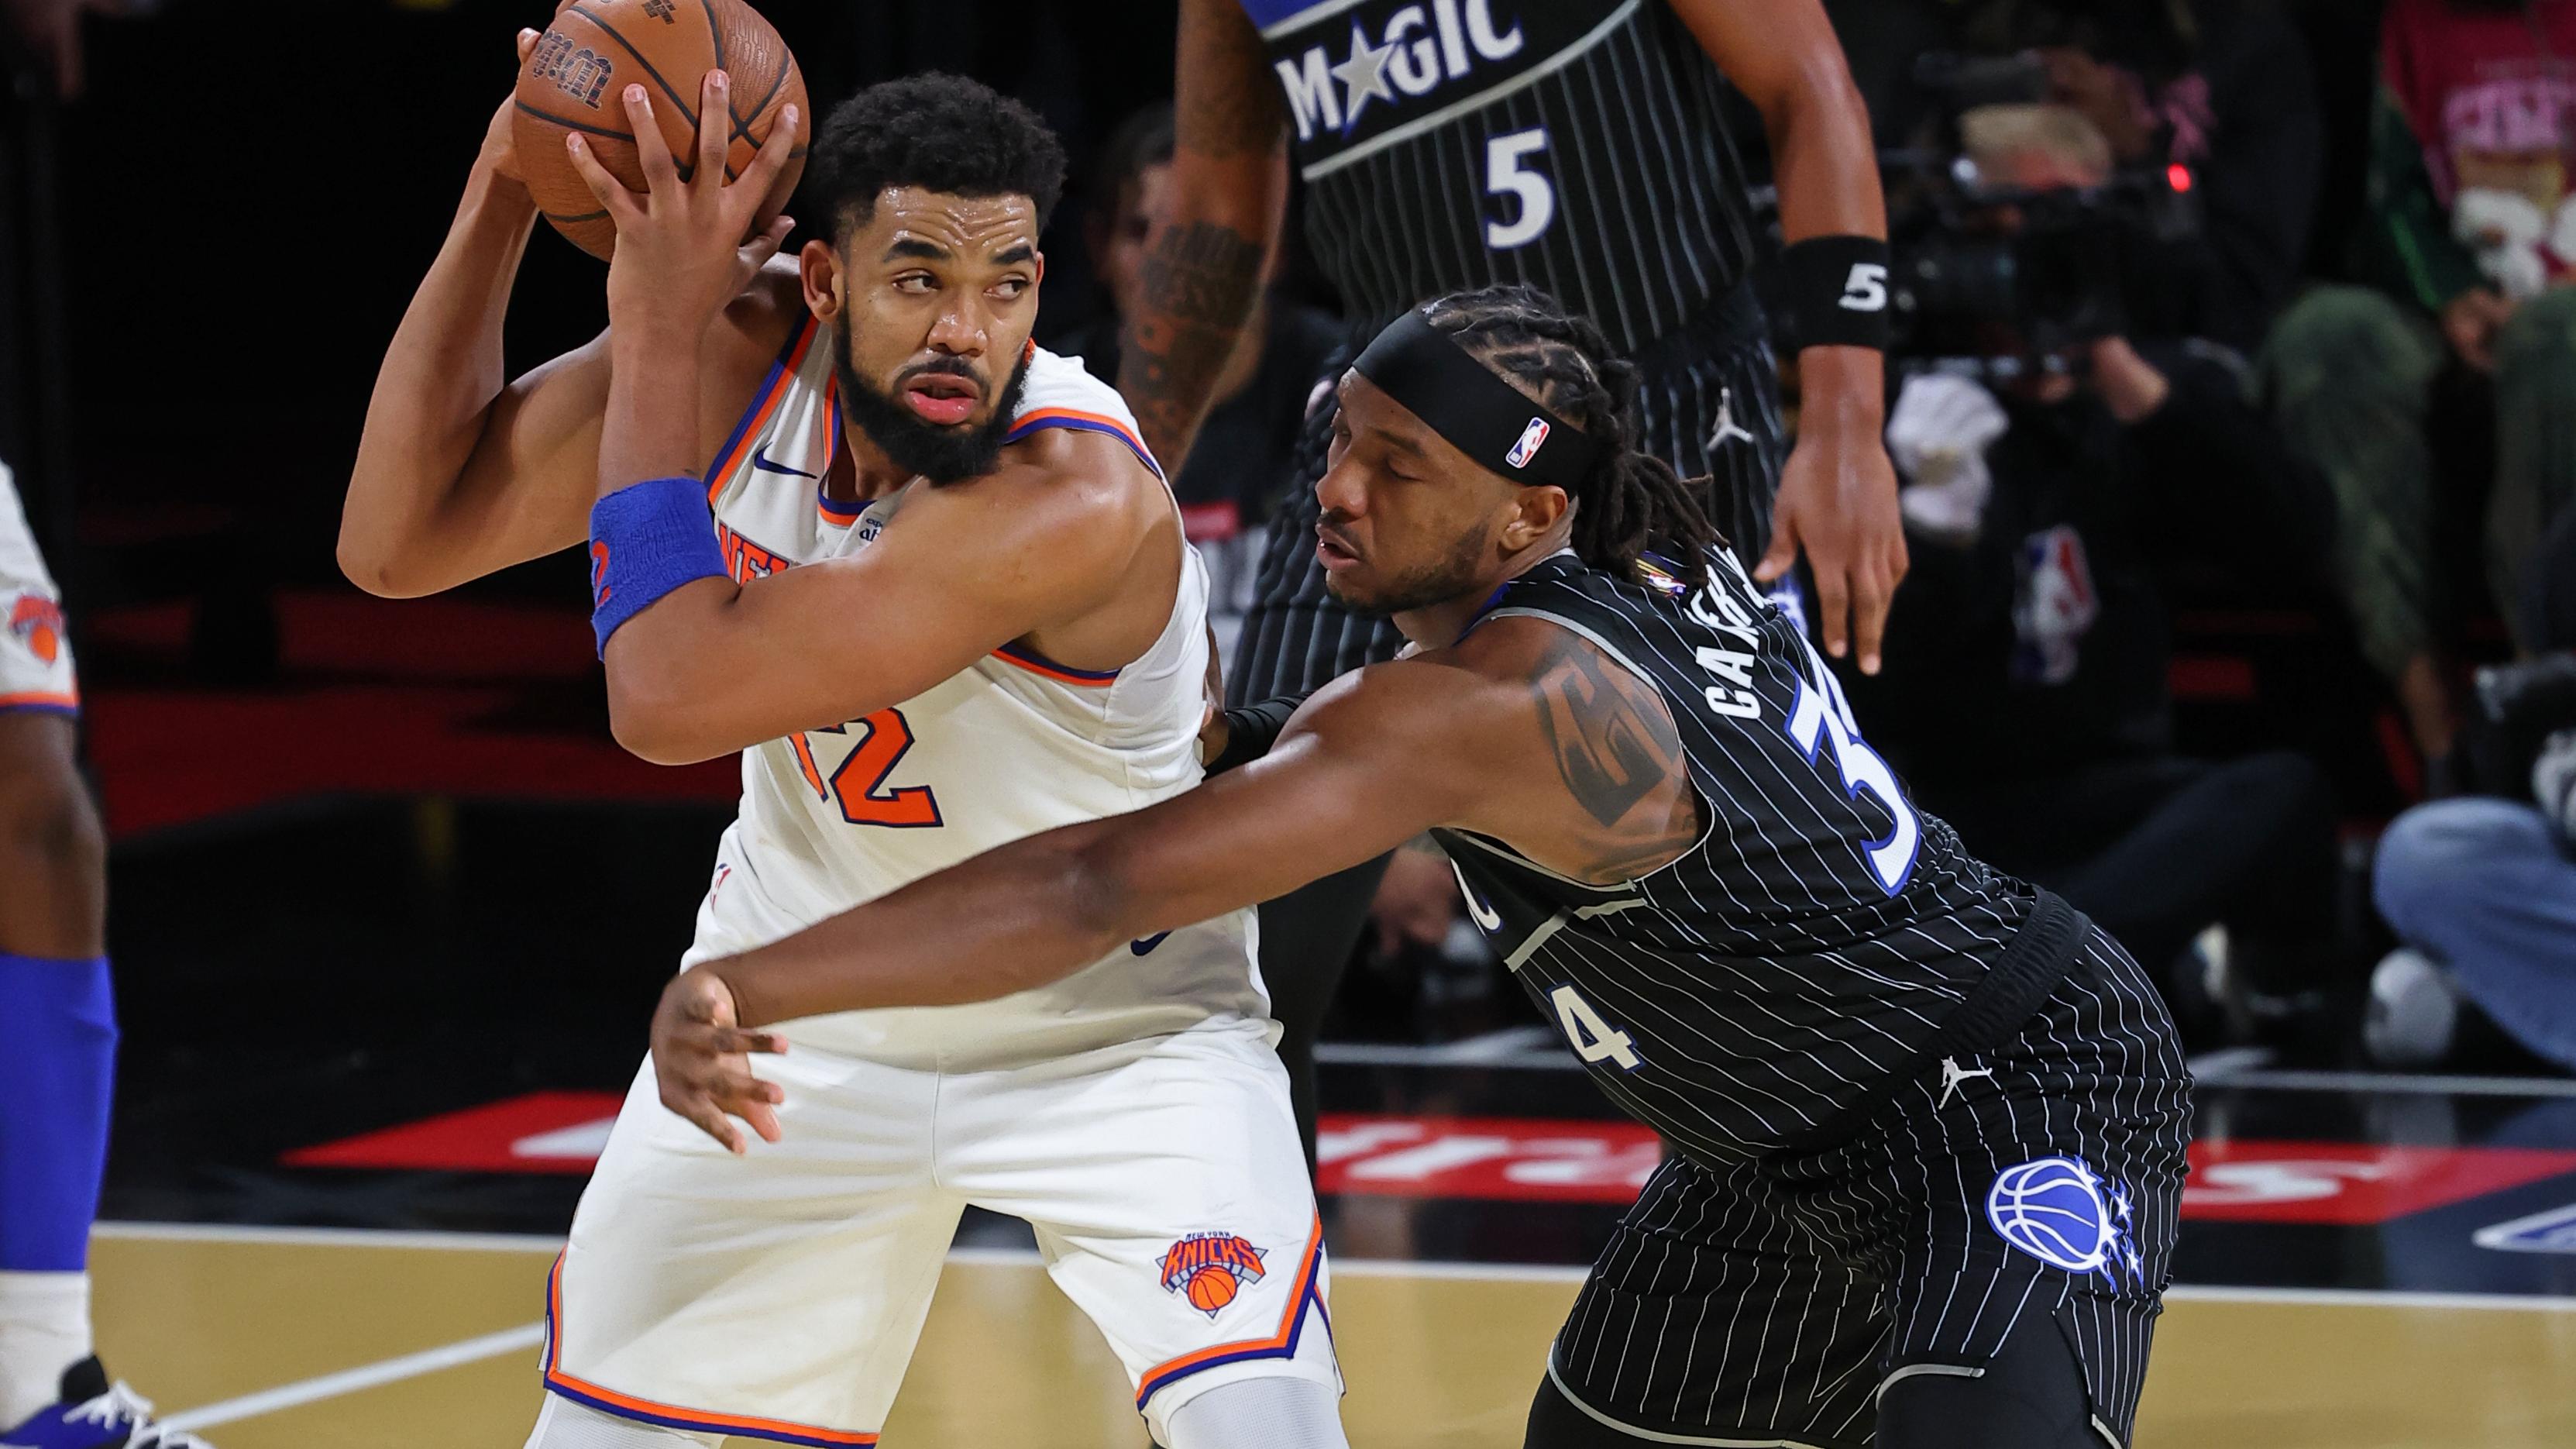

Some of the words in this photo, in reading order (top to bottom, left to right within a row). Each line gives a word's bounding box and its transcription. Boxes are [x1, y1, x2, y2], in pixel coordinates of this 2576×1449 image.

[1486, 128, 1555, 250] 5
[1838, 263, 1887, 311] 5
[1185, 1232, 1205, 1241] NEW
[1207, 1230, 1231, 1239] YORK
[1161, 1235, 1267, 1287] KNICKS
